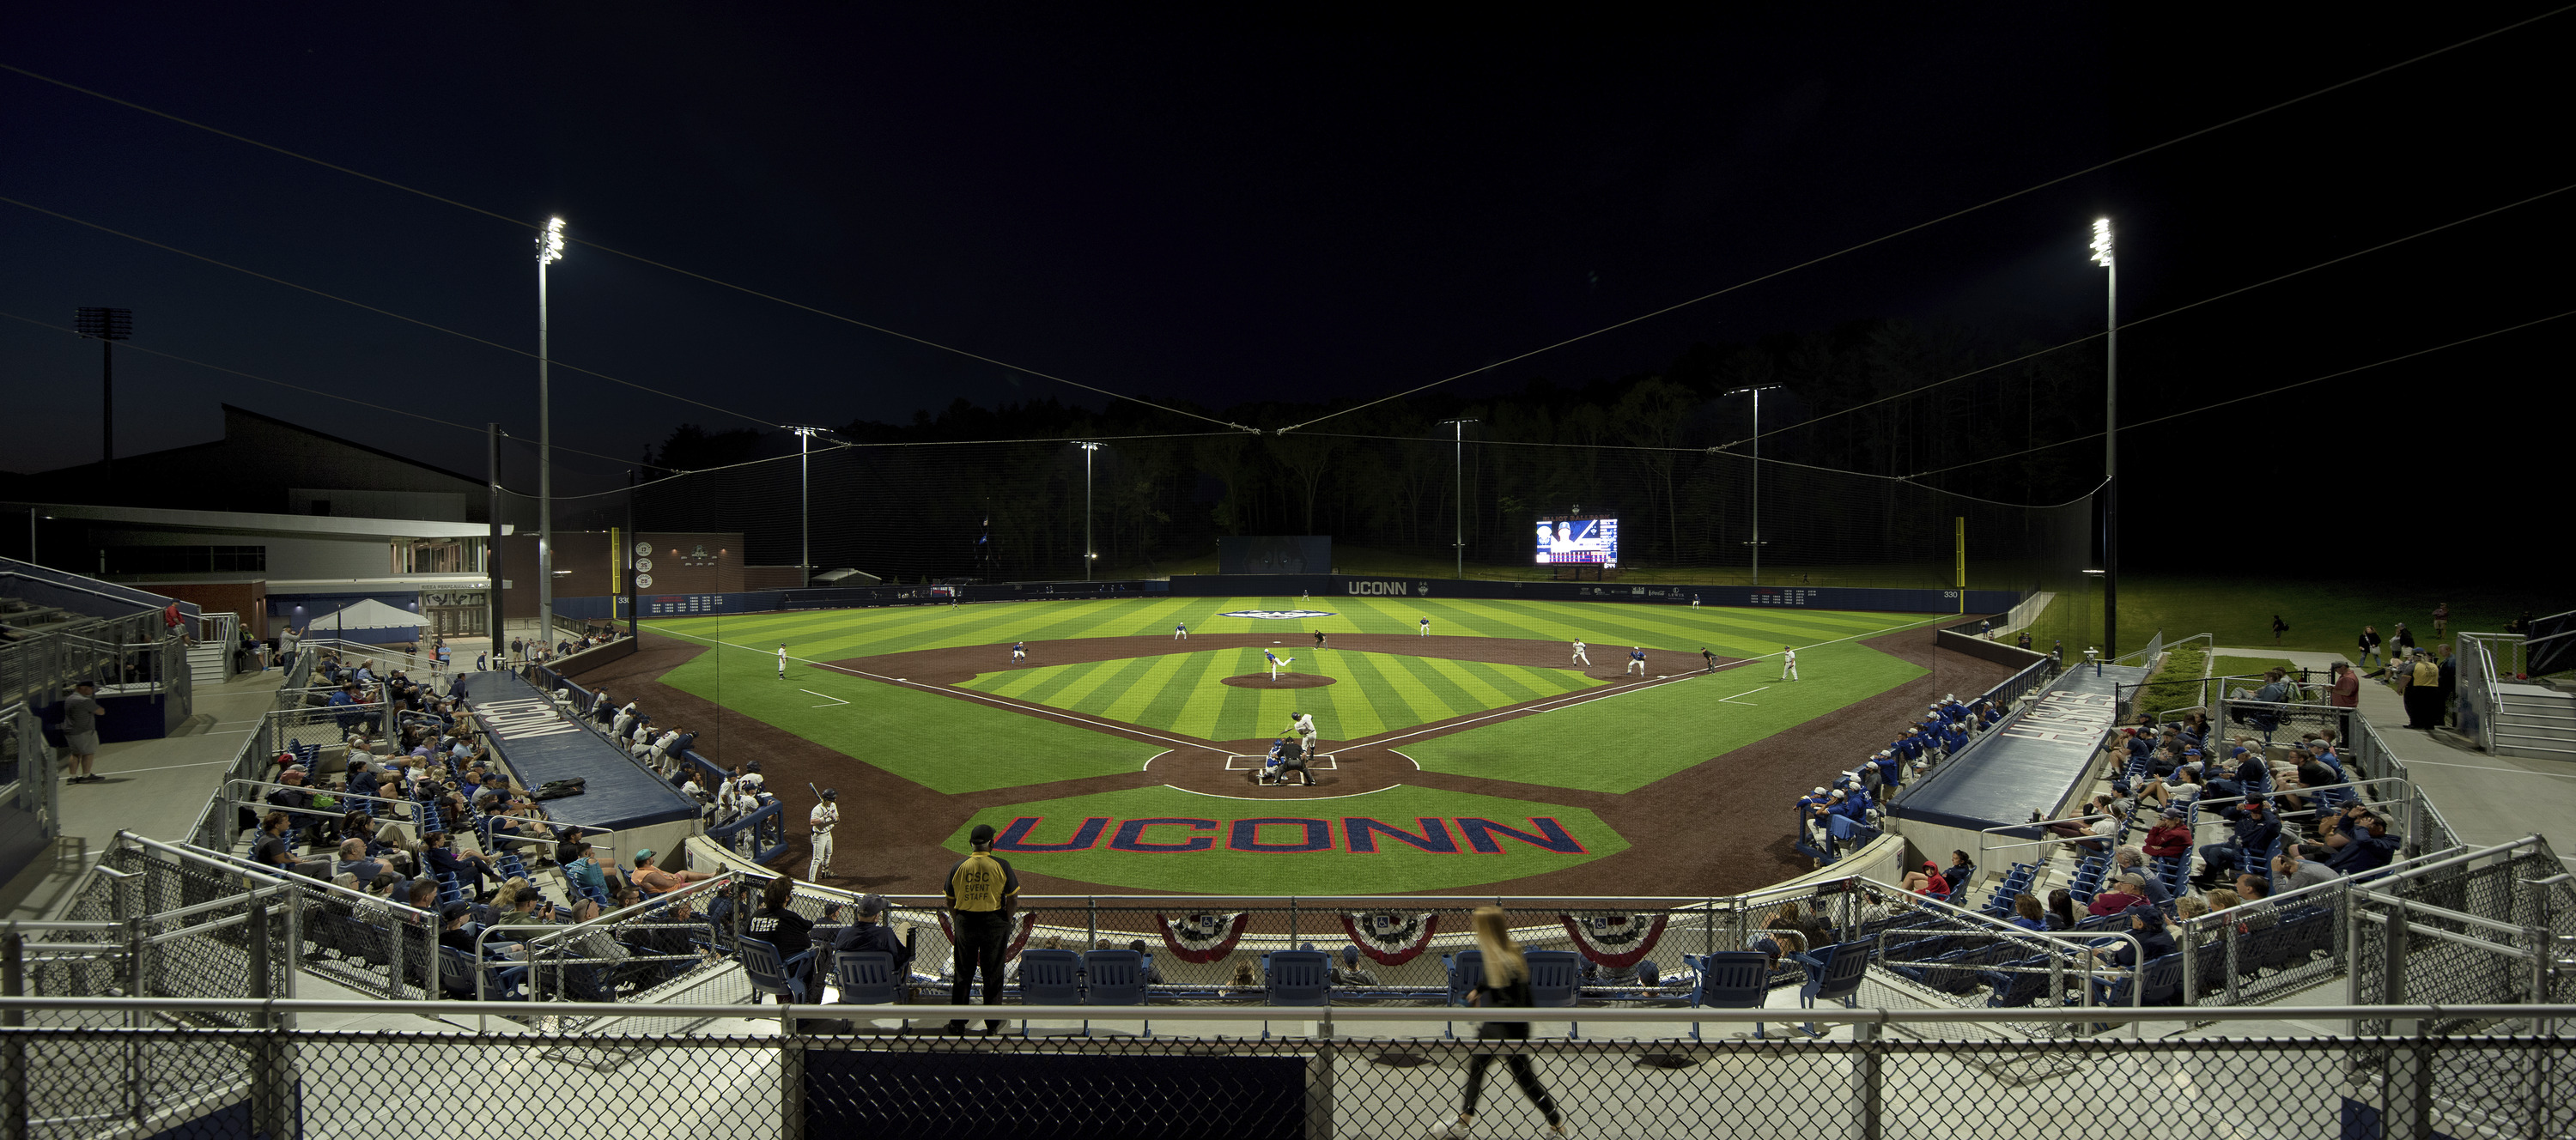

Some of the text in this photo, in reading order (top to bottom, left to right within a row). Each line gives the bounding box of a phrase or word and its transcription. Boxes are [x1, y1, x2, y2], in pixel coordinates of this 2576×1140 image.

[1348, 581, 1407, 595] UCONN
[474, 697, 582, 741] UCONN
[2000, 690, 2116, 746] HUSKIES
[993, 816, 1591, 855] UCONN
[965, 872, 990, 883] CSC
[965, 884, 990, 892] EVENT
[1844, 880, 1850, 890] 3
[394, 910, 418, 923] SECTION 4
[2204, 914, 2230, 927] SECTION 2
[750, 917, 779, 932] STAFF
